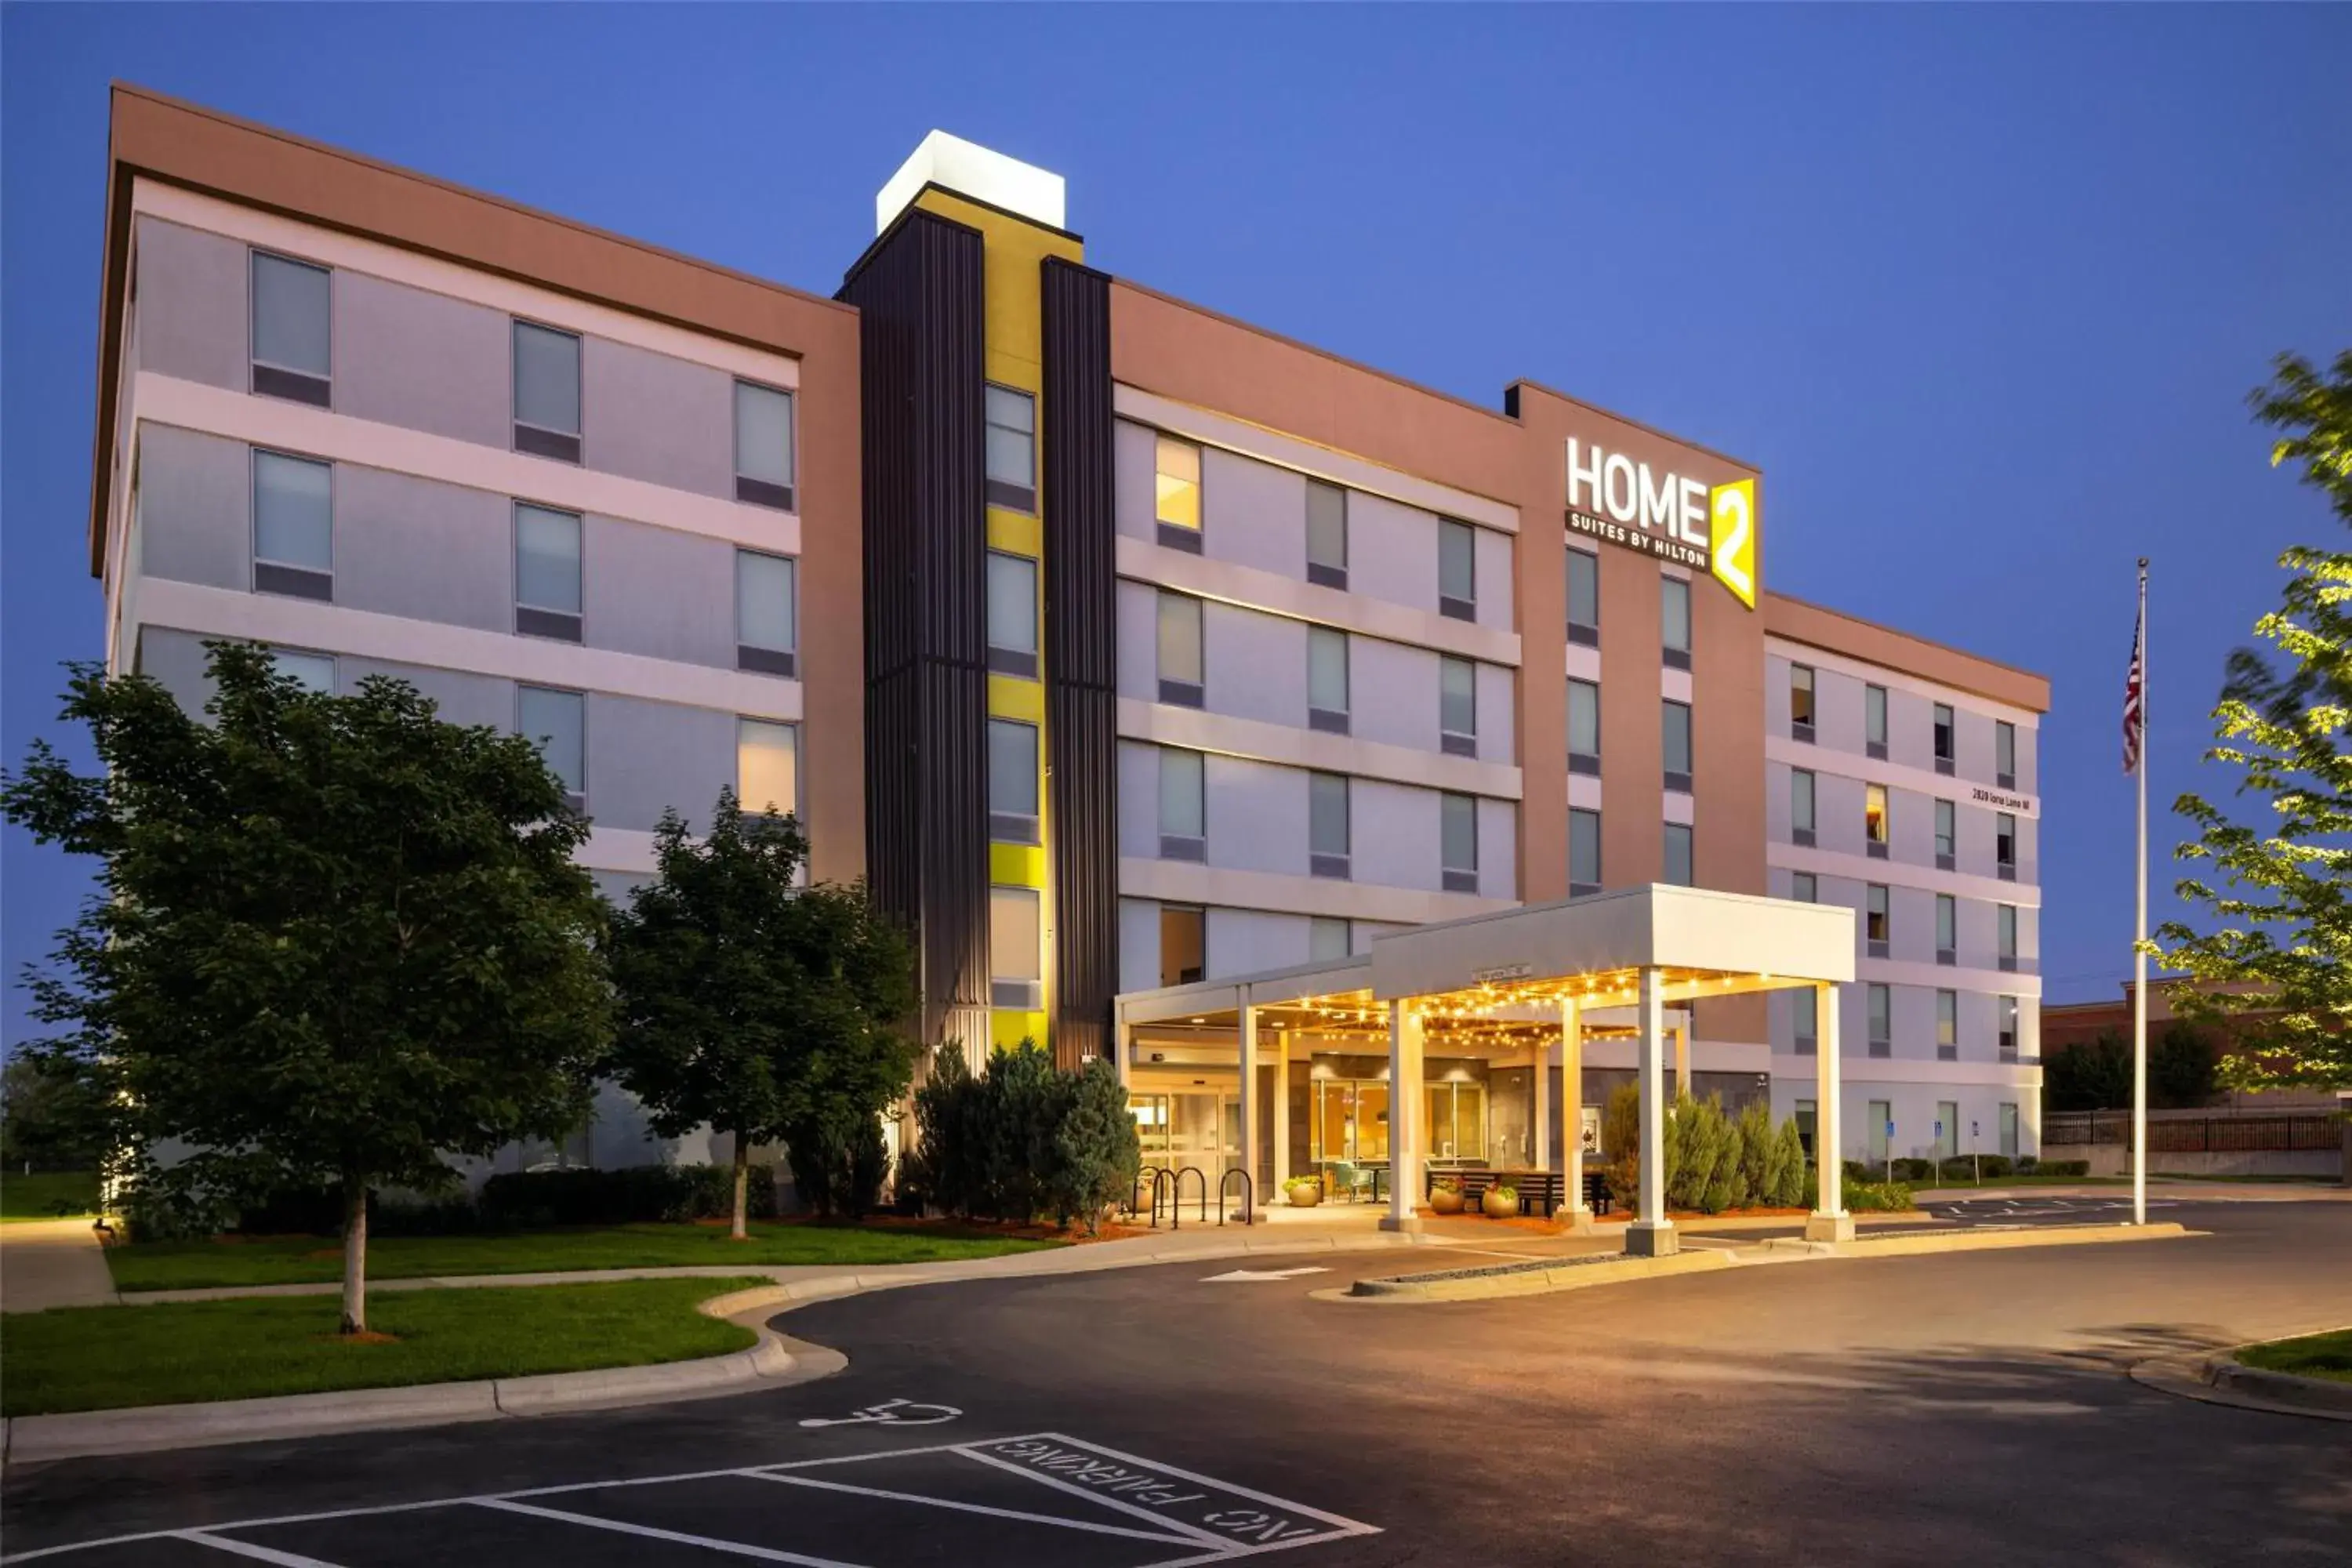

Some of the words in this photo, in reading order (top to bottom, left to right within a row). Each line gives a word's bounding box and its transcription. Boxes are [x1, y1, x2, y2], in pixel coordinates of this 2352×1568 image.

[1566, 437, 1708, 547] HOME
[1717, 488, 1751, 596] 2
[1571, 514, 1625, 541] SUITES
[1631, 532, 1649, 548] BY
[1655, 539, 1705, 566] HILTON
[996, 1440, 1207, 1505] PARKING
[1203, 1510, 1316, 1541] NO
